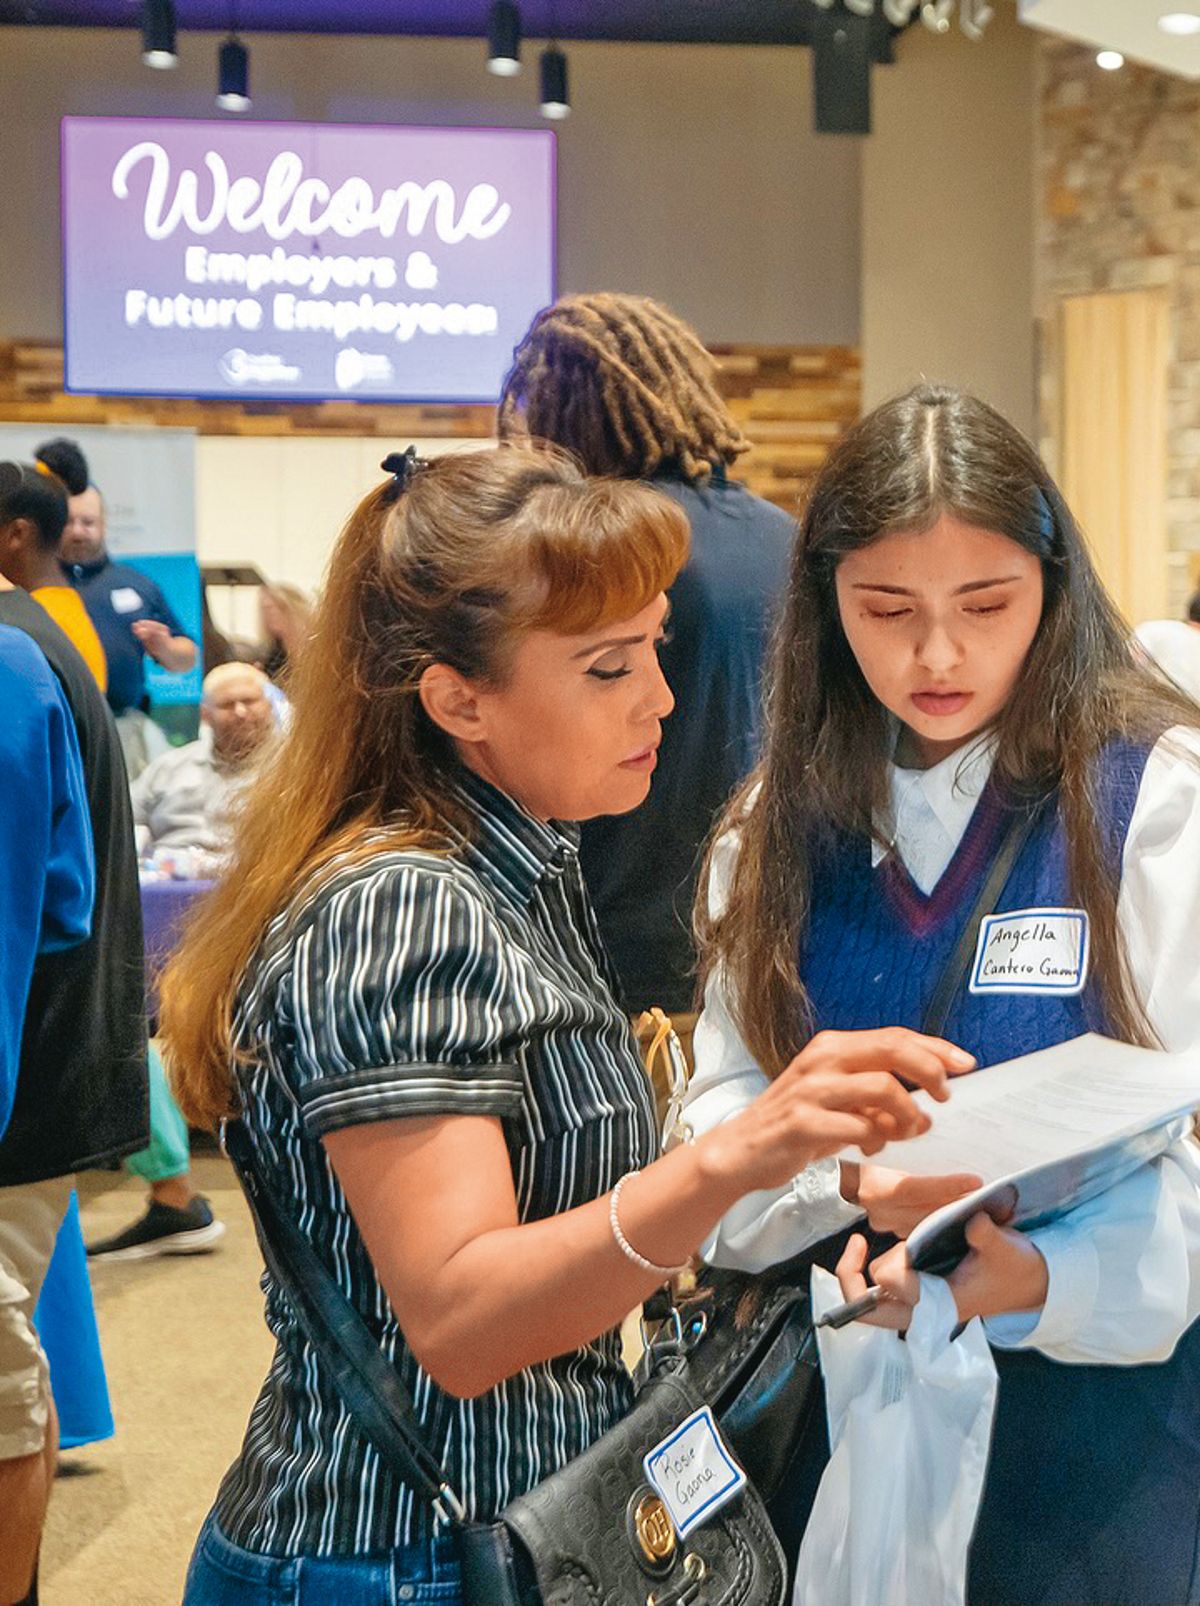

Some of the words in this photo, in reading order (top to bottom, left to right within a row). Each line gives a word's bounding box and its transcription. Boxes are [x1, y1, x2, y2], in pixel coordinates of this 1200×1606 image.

[112, 142, 511, 244] Welcome
[185, 246, 398, 294] Employers
[125, 289, 263, 330] Future
[989, 922, 1056, 952] Angella
